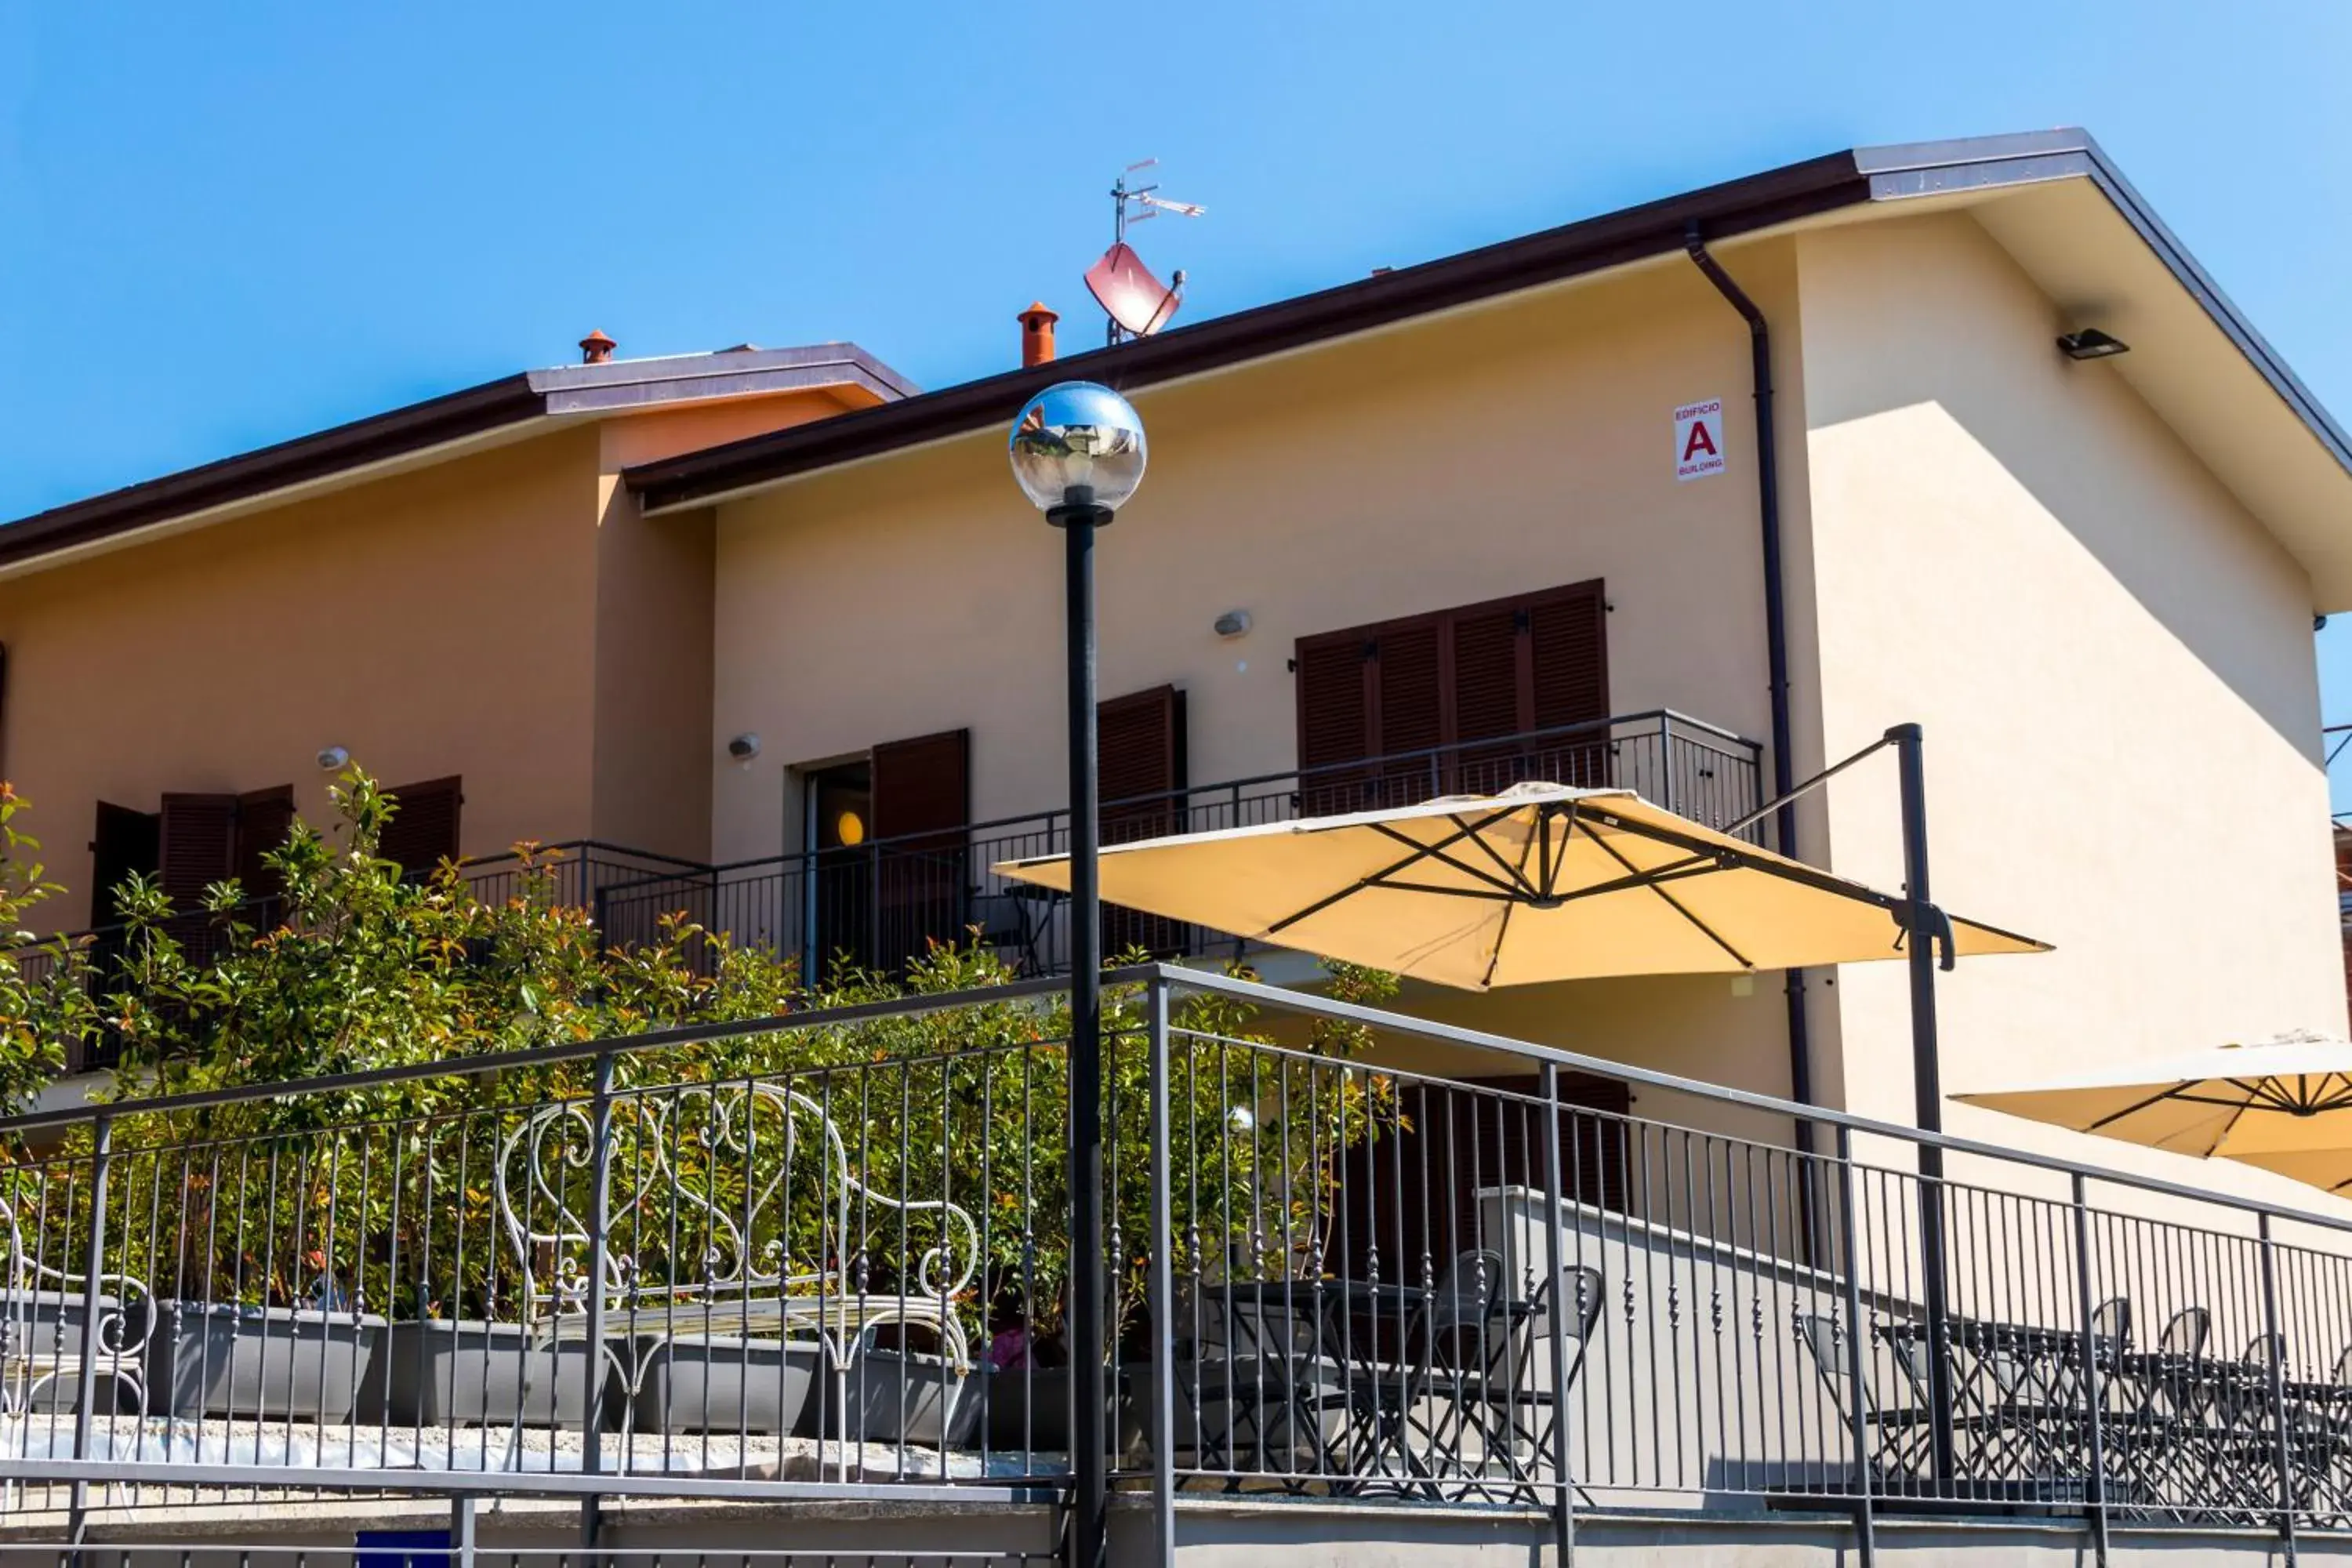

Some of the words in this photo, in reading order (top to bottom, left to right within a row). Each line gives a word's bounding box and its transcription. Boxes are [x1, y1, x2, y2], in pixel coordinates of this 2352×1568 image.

[1675, 402, 1719, 421] EDIFICIO
[1683, 421, 1717, 461] A
[1679, 459, 1722, 475] BUILDING
